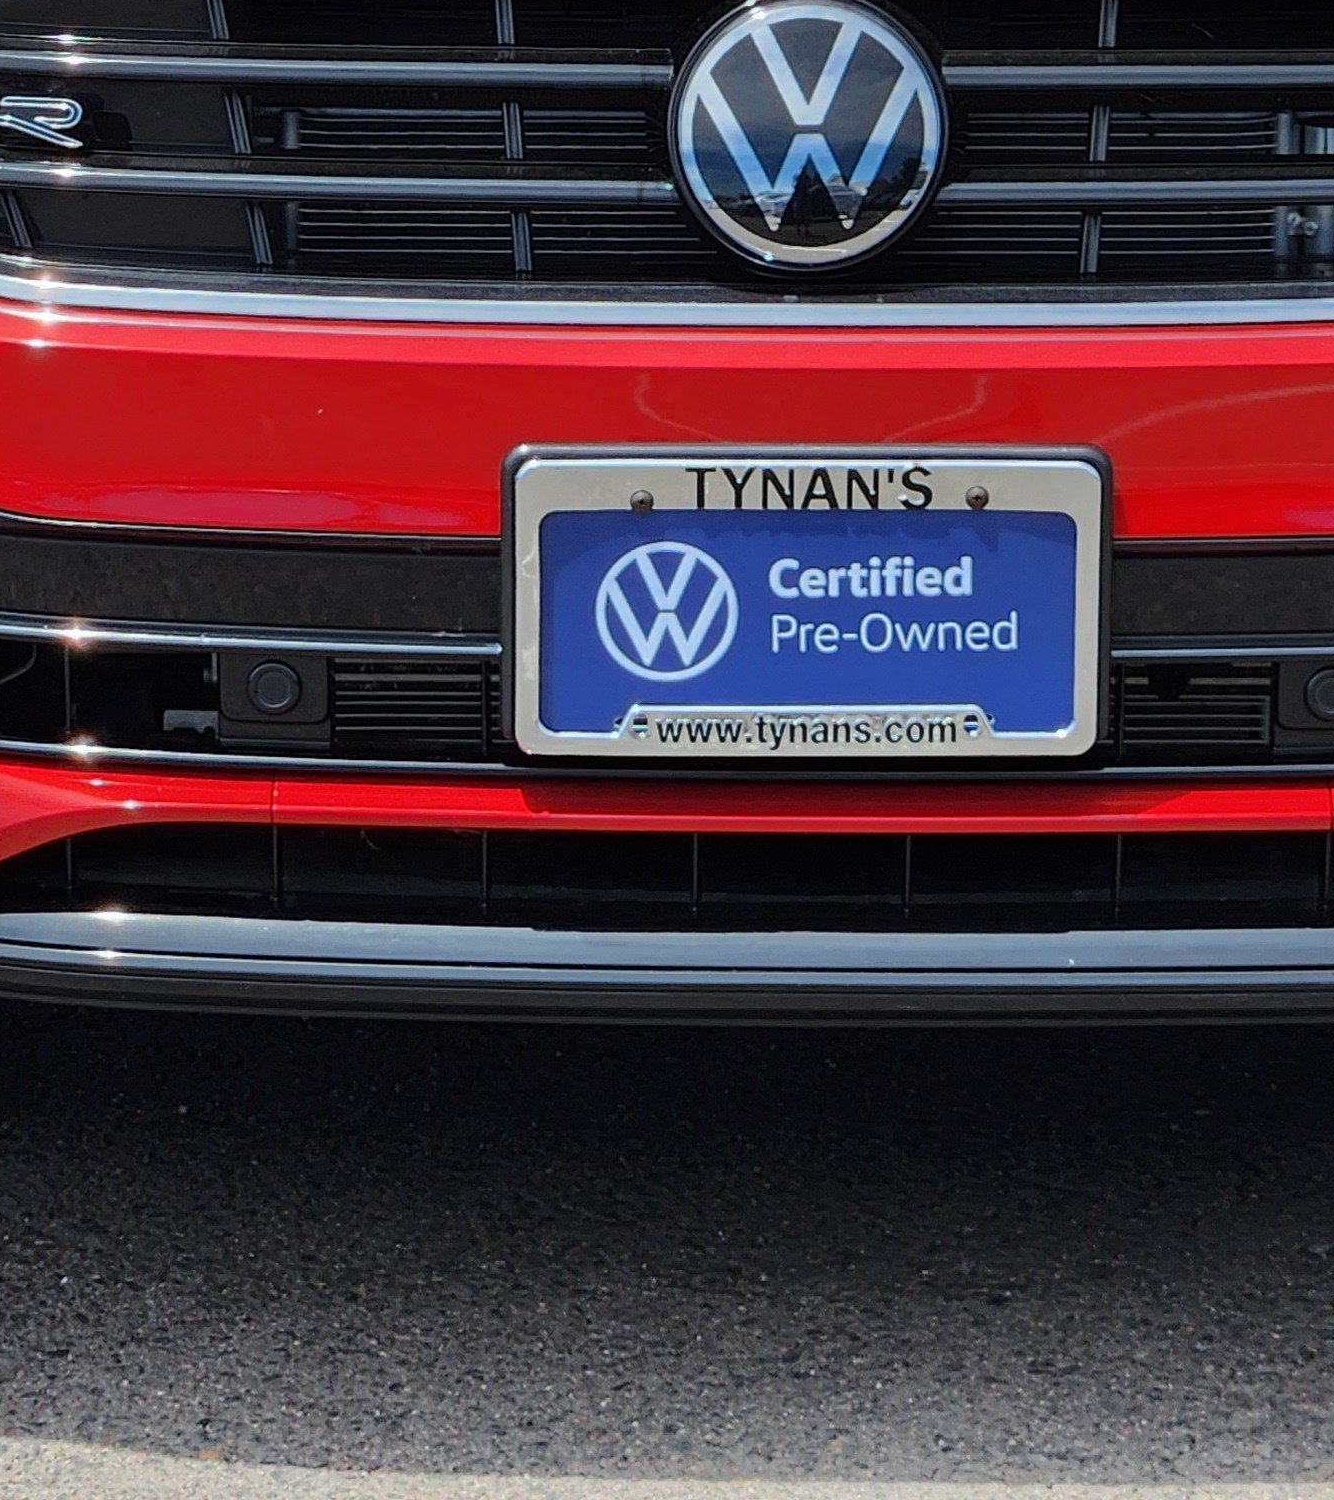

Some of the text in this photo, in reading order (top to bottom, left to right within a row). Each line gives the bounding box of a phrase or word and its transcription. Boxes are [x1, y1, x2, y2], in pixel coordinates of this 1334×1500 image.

[678, 5, 940, 255] VW
[685, 466, 934, 510] TYNAN'S
[768, 555, 973, 598] Certified
[596, 541, 738, 679] VW
[771, 610, 1018, 654] Pre-Owned
[657, 714, 958, 750] www.tynans.com
